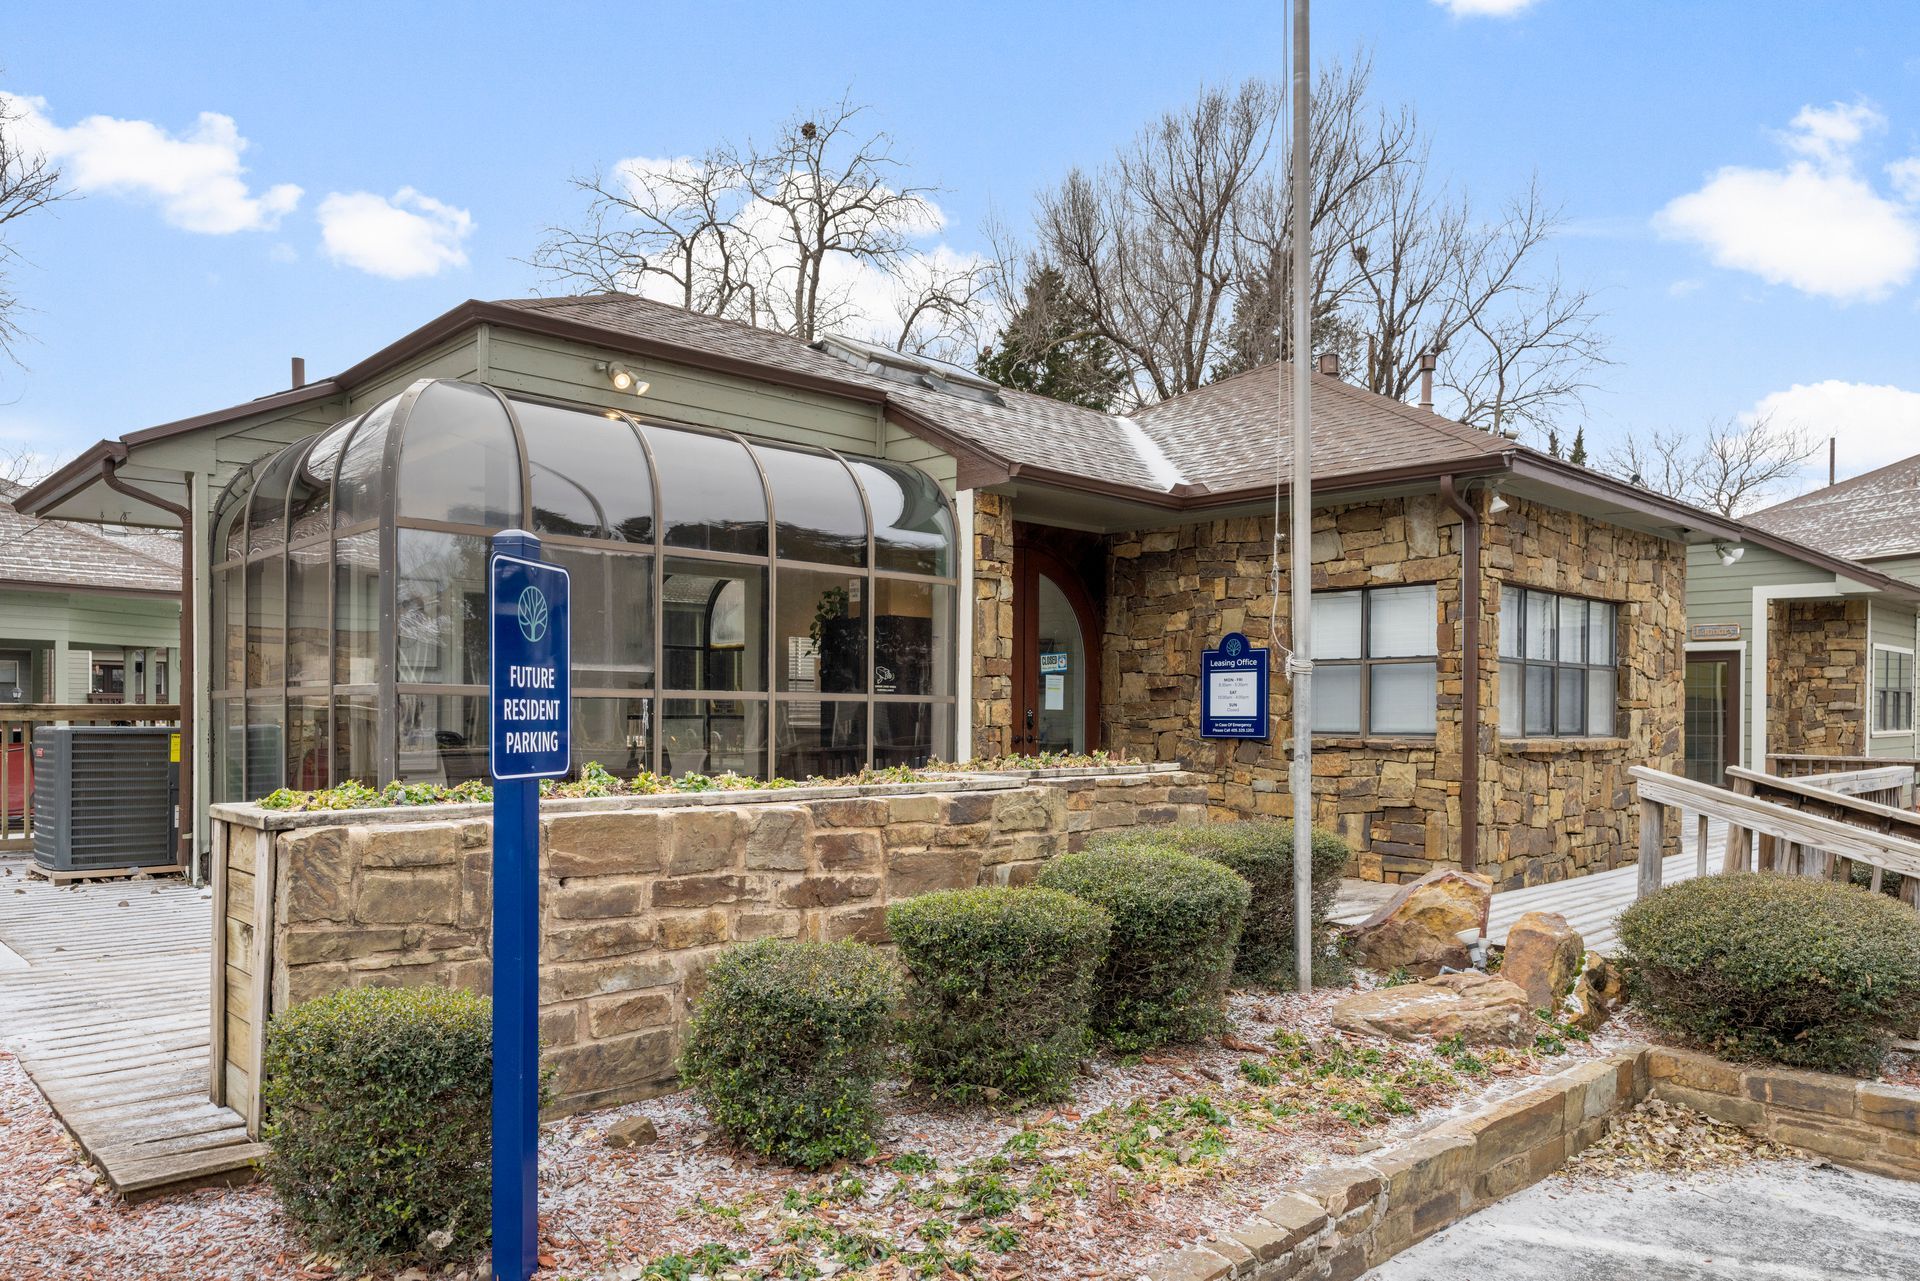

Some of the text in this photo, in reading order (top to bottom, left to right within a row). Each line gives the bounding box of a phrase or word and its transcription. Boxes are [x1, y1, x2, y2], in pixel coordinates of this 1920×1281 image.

[1041, 655, 1058, 666] CLOSED
[1210, 658, 1258, 668] Leasing Office
[510, 665, 555, 689] FUTURE
[504, 698, 561, 721] RESIDENT
[506, 731, 559, 754] PARKING
